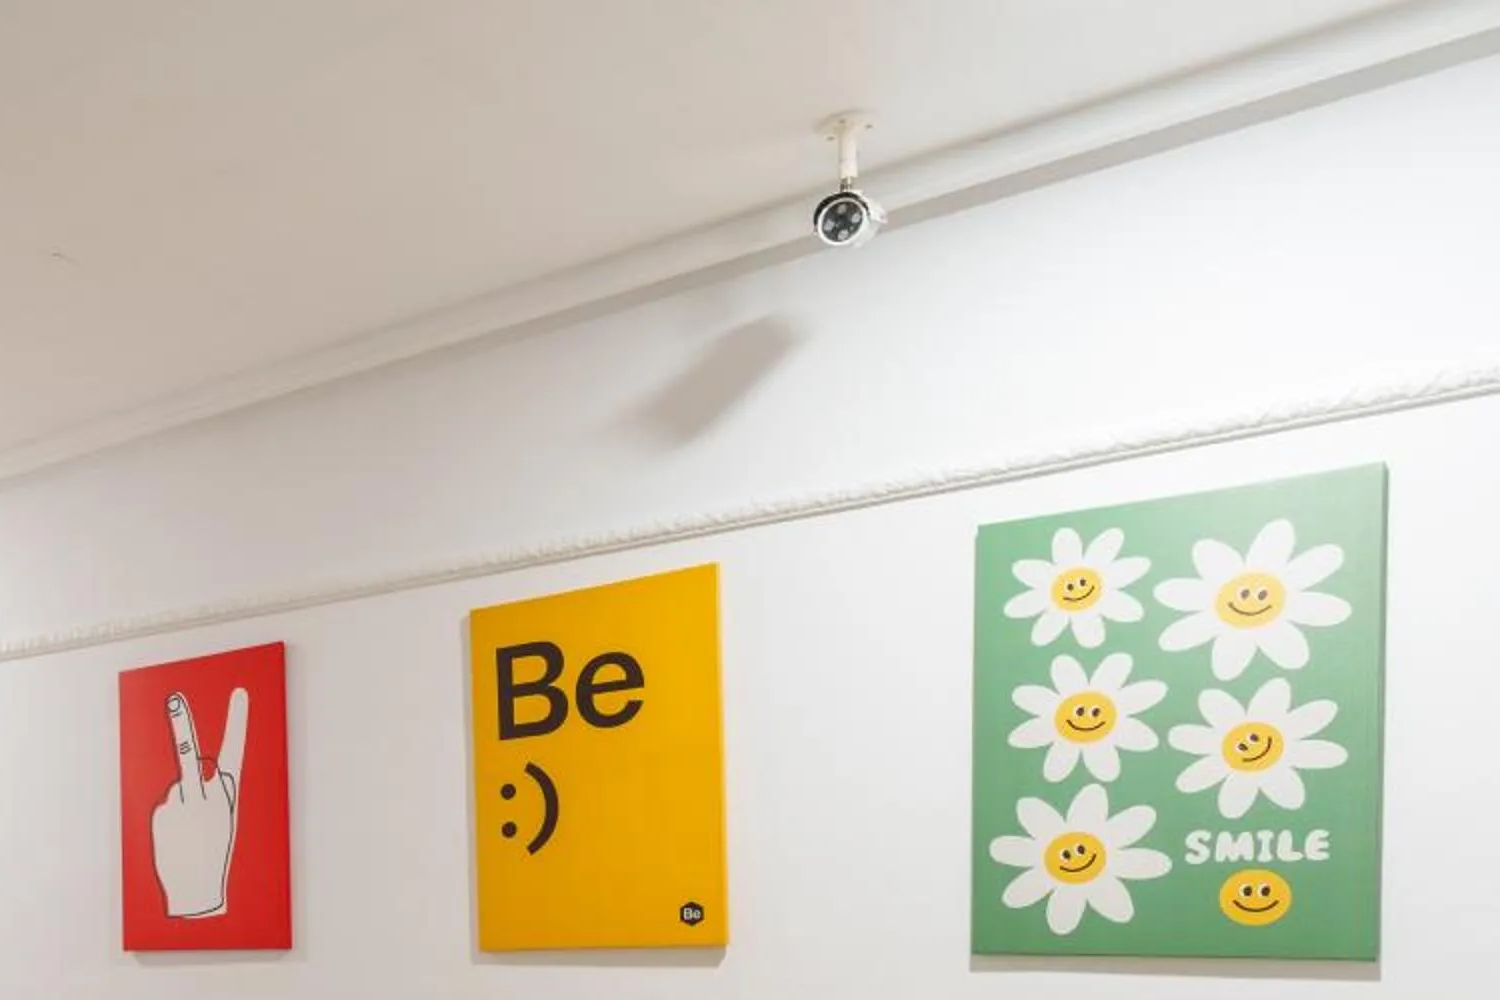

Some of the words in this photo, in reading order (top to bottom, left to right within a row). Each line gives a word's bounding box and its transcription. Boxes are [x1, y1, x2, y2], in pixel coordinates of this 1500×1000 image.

[496, 641, 645, 740] Be
[1185, 829, 1330, 864] SMILE
[683, 907, 701, 921] Be
